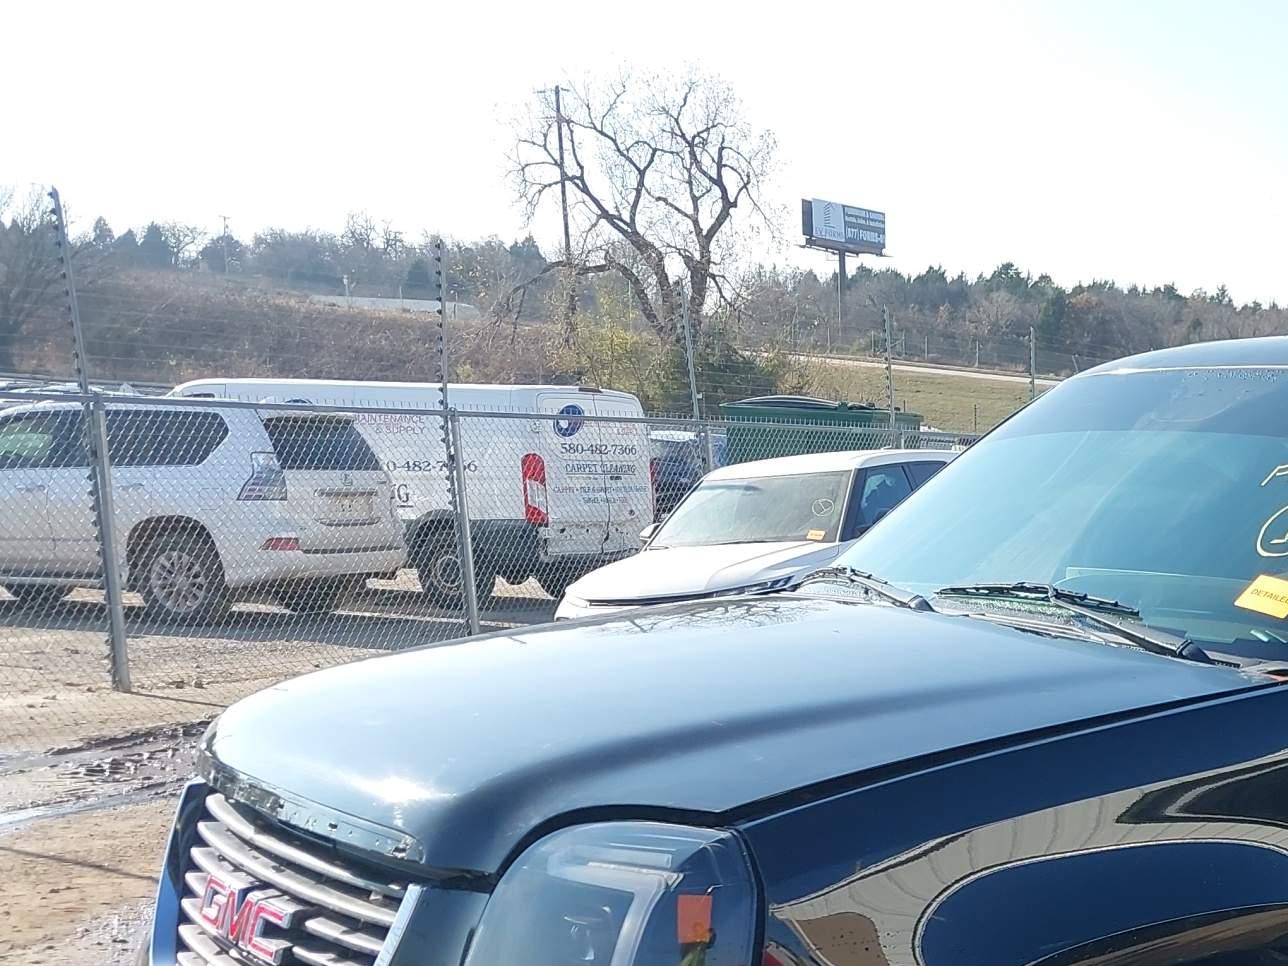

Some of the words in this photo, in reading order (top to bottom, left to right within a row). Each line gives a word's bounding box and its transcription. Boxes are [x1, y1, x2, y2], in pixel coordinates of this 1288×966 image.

[386, 425, 424, 434] SUPPLY
[560, 442, 637, 455] 580-482-7366
[565, 463, 598, 473] CARPET
[601, 463, 636, 473] CLEANING
[201, 872, 294, 966] GMC
